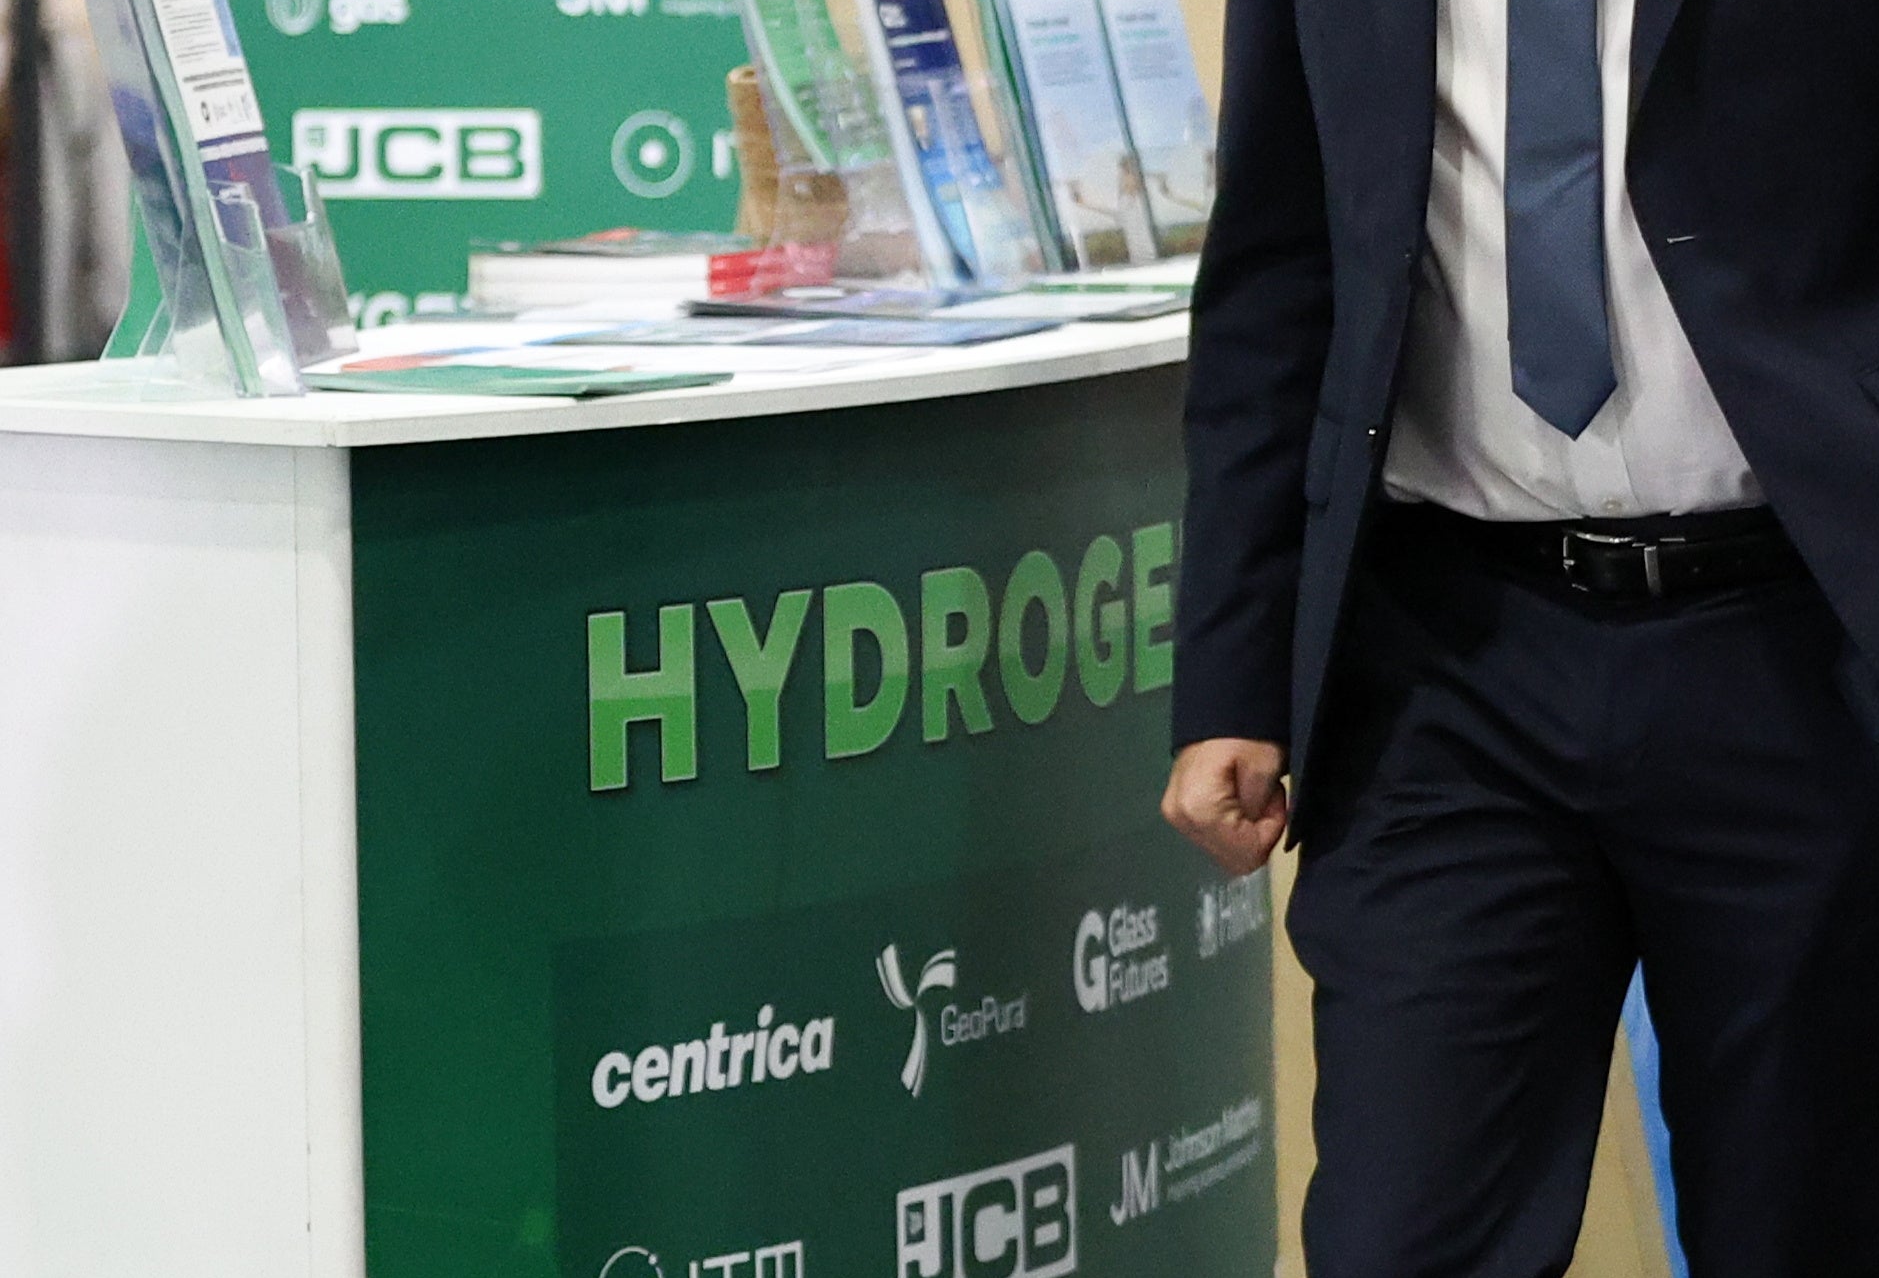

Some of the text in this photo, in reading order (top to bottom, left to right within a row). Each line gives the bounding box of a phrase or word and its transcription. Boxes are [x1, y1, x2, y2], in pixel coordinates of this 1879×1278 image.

[302, 119, 529, 186] JCB
[587, 519, 1184, 793] HYDROGE
[1109, 903, 1158, 957] Glass
[1109, 952, 1170, 1006] Futures
[941, 994, 1027, 1046] GeoPura
[592, 1003, 836, 1109] centrica
[1110, 1139, 1160, 1227] JM
